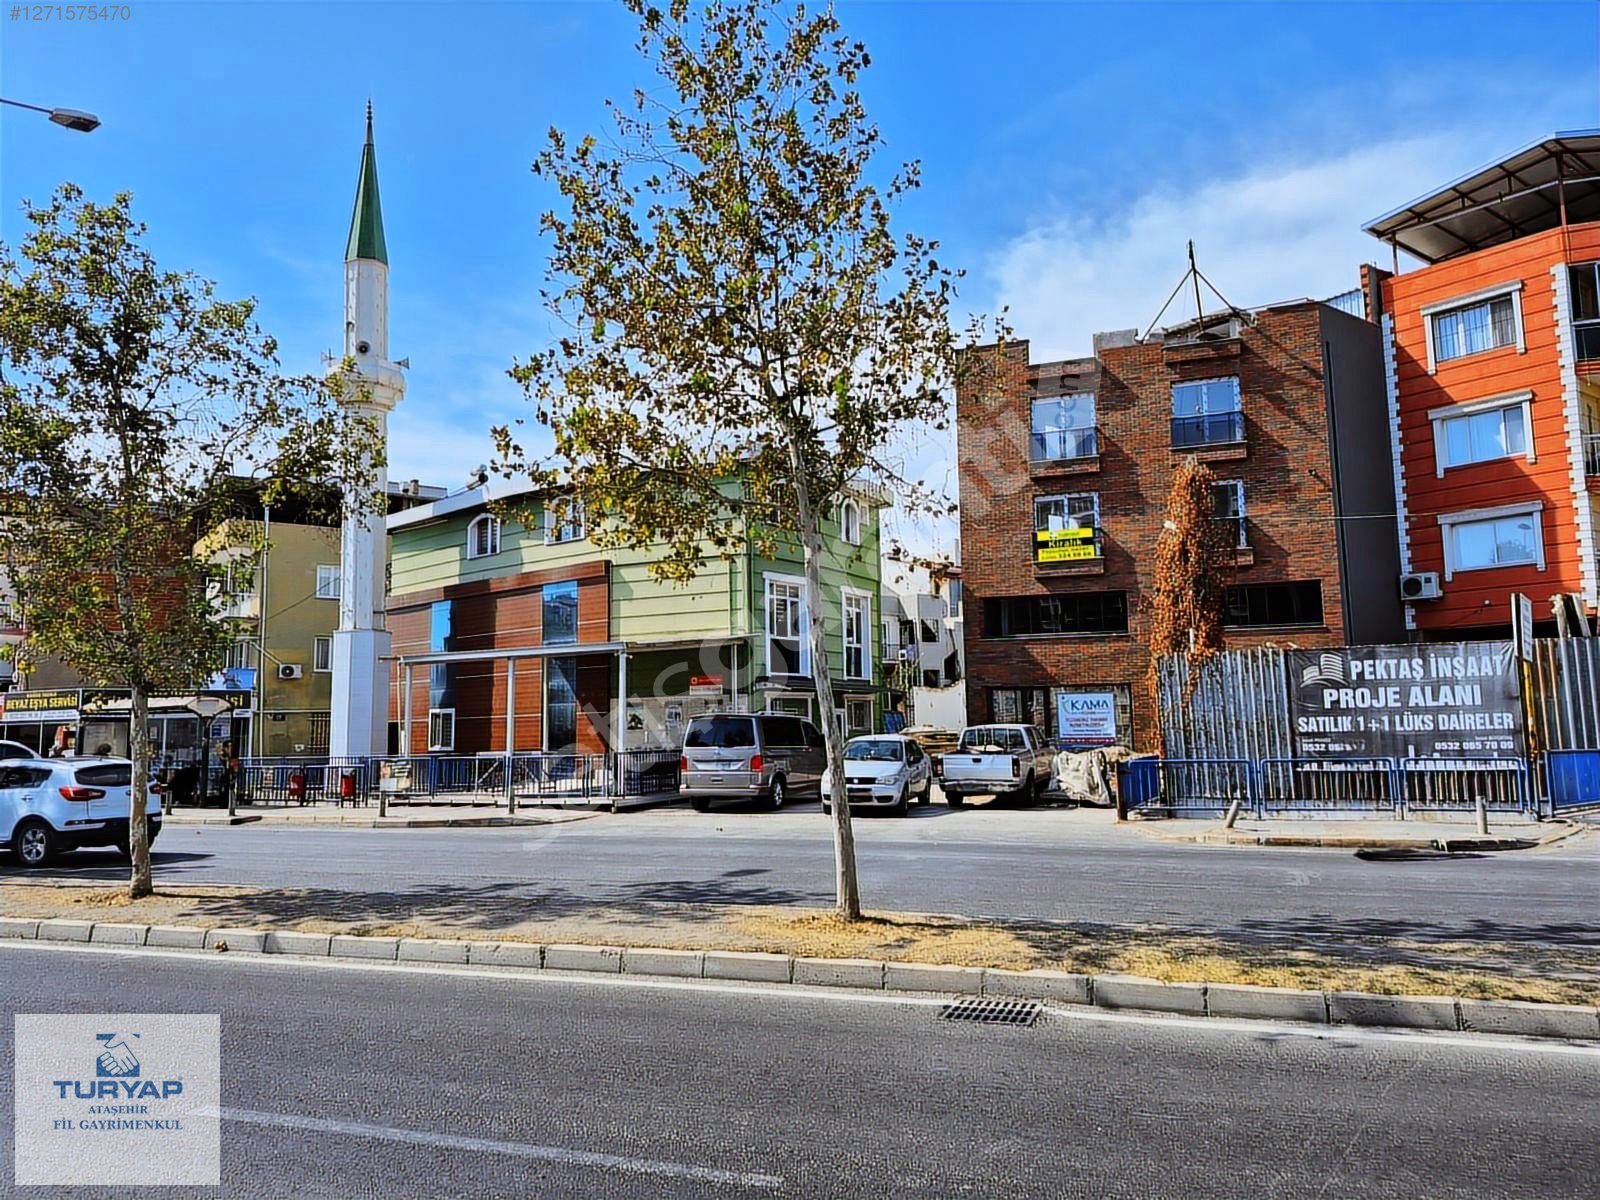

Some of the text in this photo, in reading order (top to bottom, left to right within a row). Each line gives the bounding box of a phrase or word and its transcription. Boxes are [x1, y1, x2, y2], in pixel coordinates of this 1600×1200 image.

[1350, 653, 1504, 681] PEKTAŞ İNŞAAT
[1070, 699, 1109, 711] KAMA
[1323, 685, 1482, 709] PROJE ALANI
[1298, 715, 1353, 733] SATILIK
[1394, 712, 1434, 732] LÜKS
[1438, 711, 1514, 731] DAİRELER
